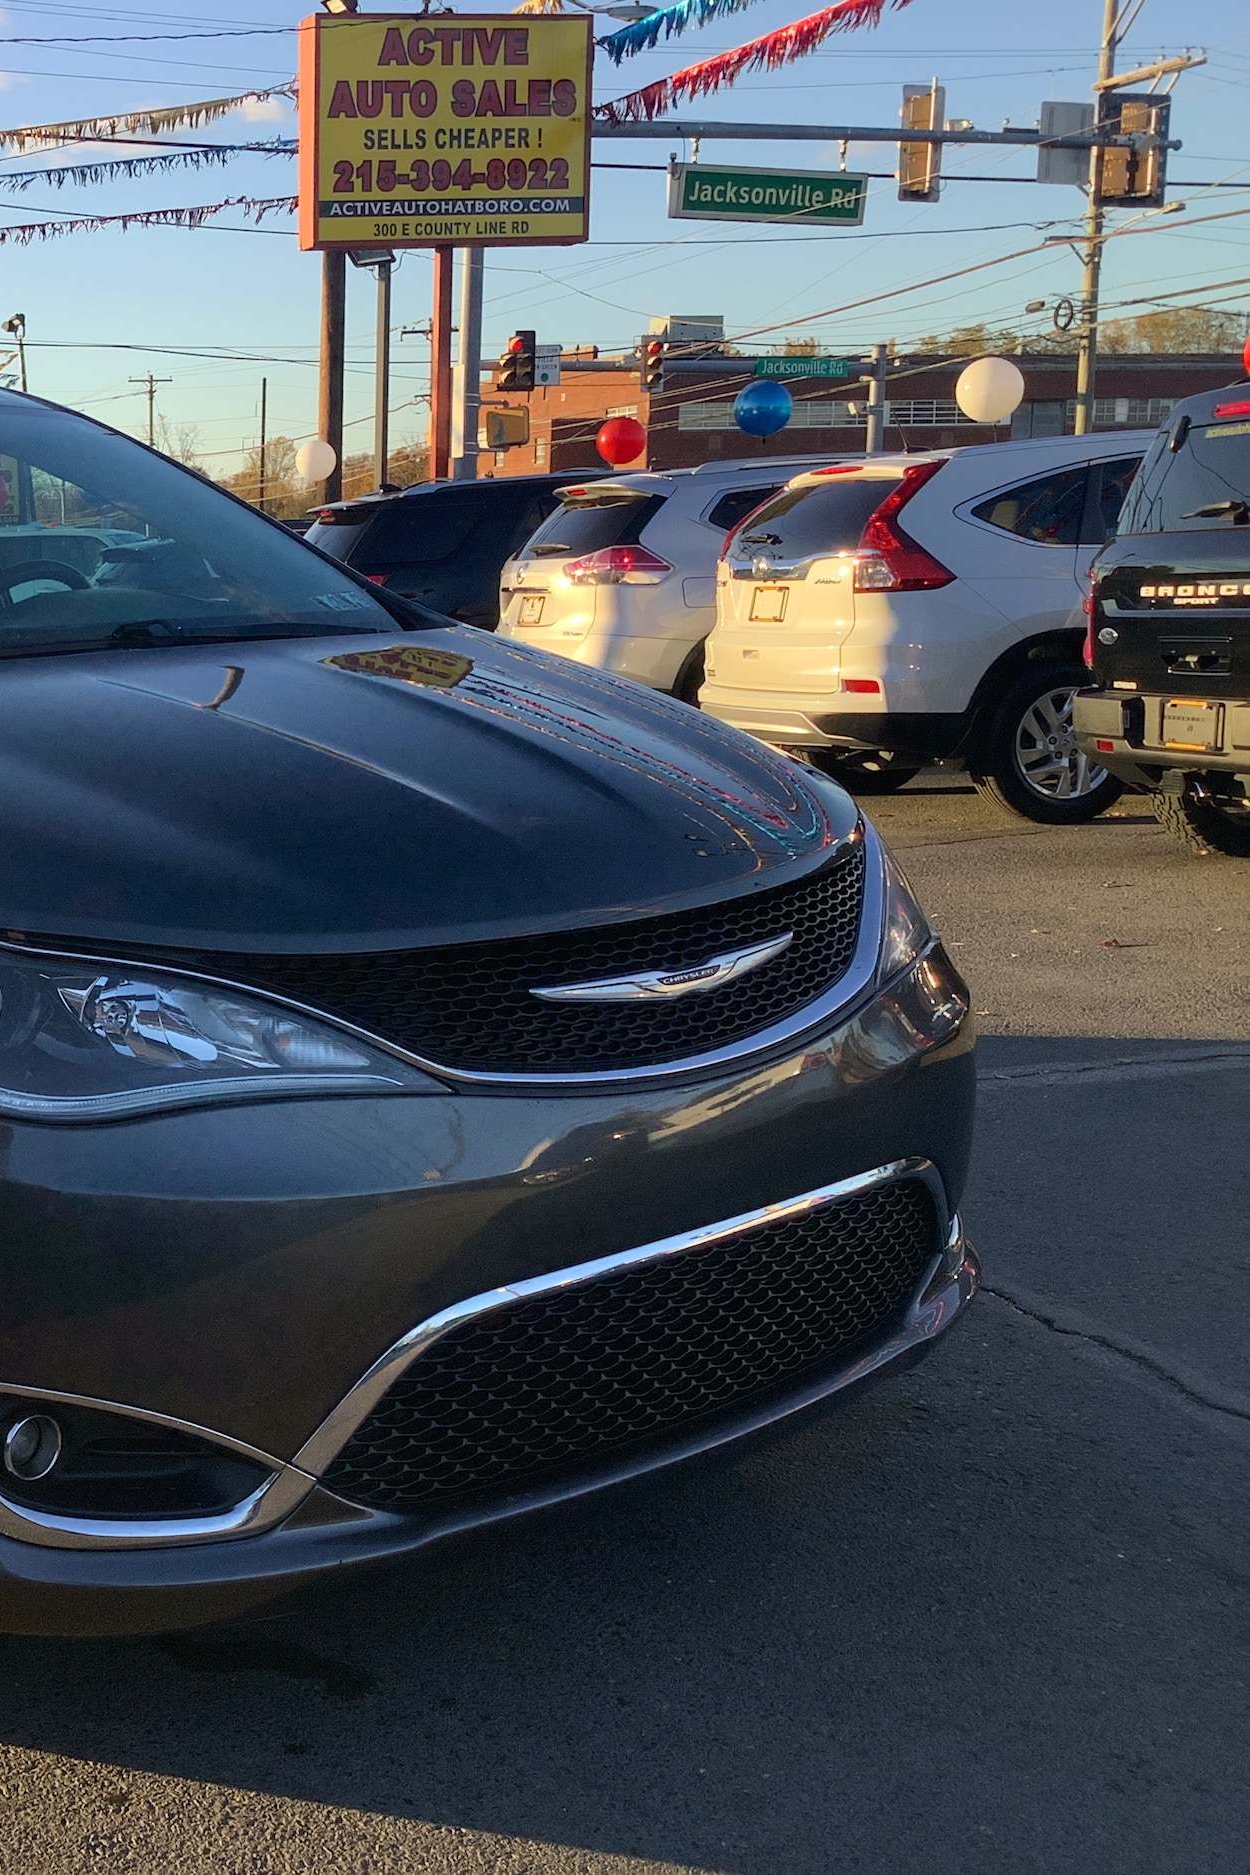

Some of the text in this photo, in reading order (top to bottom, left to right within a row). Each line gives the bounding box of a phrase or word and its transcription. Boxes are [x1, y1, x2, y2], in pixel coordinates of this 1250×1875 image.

[377, 27, 529, 66] ACTIVE
[327, 78, 577, 119] AUTO SALES
[363, 128, 427, 150] SELLS
[434, 127, 530, 149] CHEAPER
[333, 158, 570, 193] 215-394-8922
[688, 180, 857, 210] Jacksonville Rd
[330, 199, 570, 217] ACTIVEAUTOHATBORO.COM
[373, 221, 529, 237] 300 E COUNTY LINE RD
[761, 359, 843, 375] Jacksonville Rd
[1173, 597, 1219, 605] SPORT
[662, 968, 715, 984] CHRYSLER
